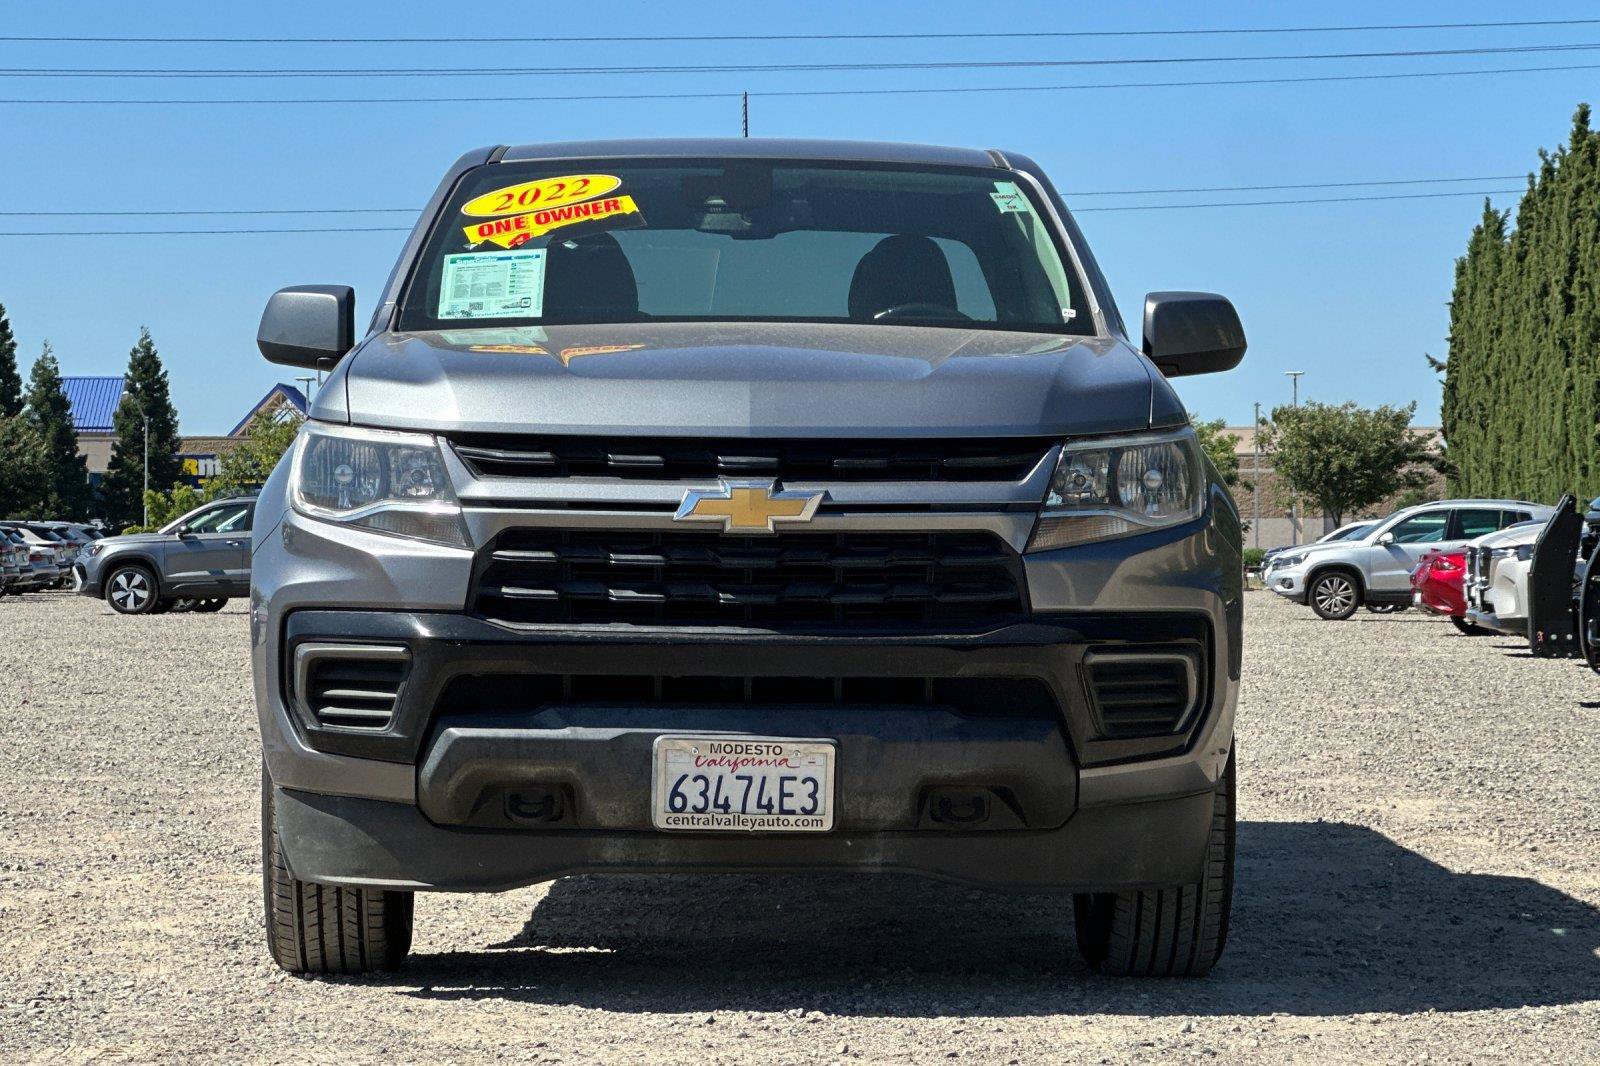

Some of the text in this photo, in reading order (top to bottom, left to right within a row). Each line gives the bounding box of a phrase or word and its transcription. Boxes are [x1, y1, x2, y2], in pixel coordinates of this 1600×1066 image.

[493, 178, 591, 212] 2022
[478, 198, 621, 238] ONE OWNER
[709, 743, 783, 756] MODESTO
[694, 754, 800, 774] California
[668, 773, 819, 815] 63474E3
[665, 813, 824, 830] centralvalleyauto.com
